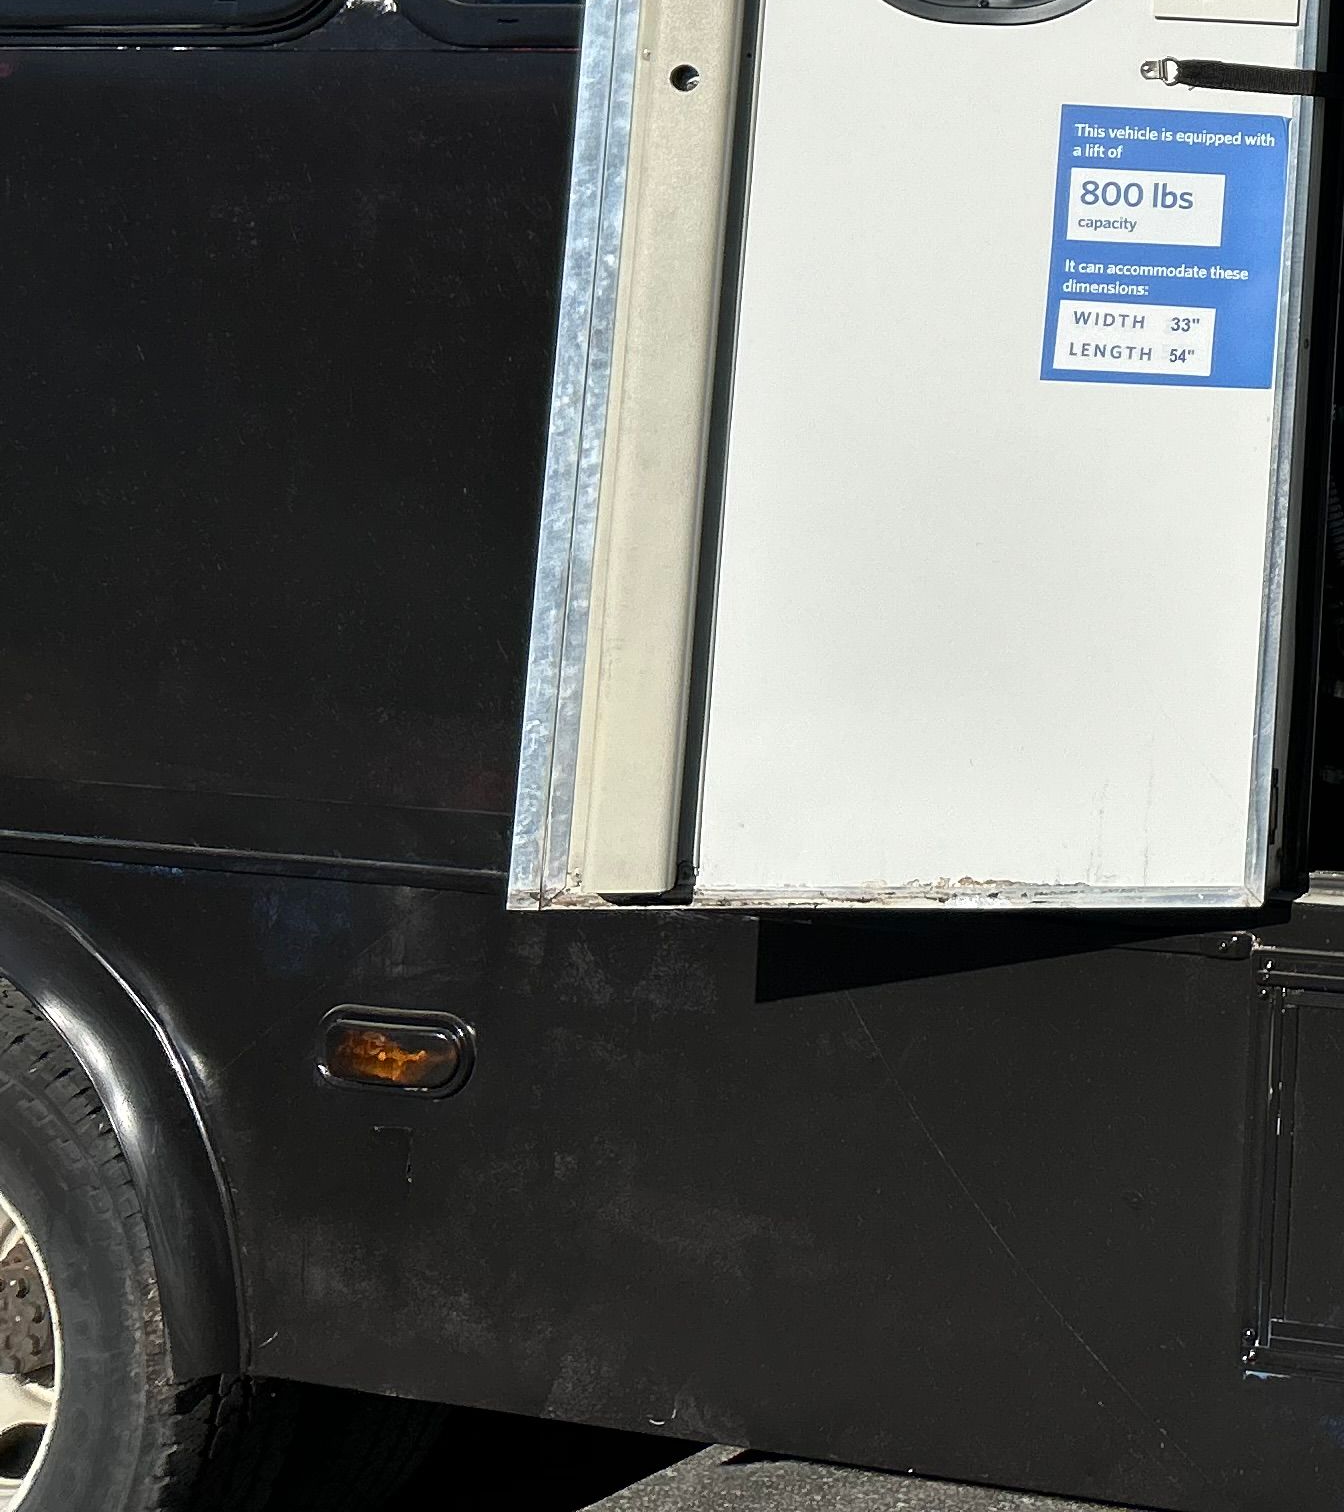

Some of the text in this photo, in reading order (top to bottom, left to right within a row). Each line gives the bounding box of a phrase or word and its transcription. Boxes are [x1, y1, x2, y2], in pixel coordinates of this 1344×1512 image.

[1075, 124, 1275, 147] This vehicle is equipped with
[1072, 144, 1124, 159] a lift of
[1080, 180, 1194, 209] 800 lbs
[1078, 217, 1137, 233] capacity
[1065, 259, 1249, 280] It can accommodate these
[1063, 279, 1149, 296] dimensions:
[1073, 310, 1200, 333] WIDTH 33"
[1068, 342, 1195, 363] LENGTH 54"
